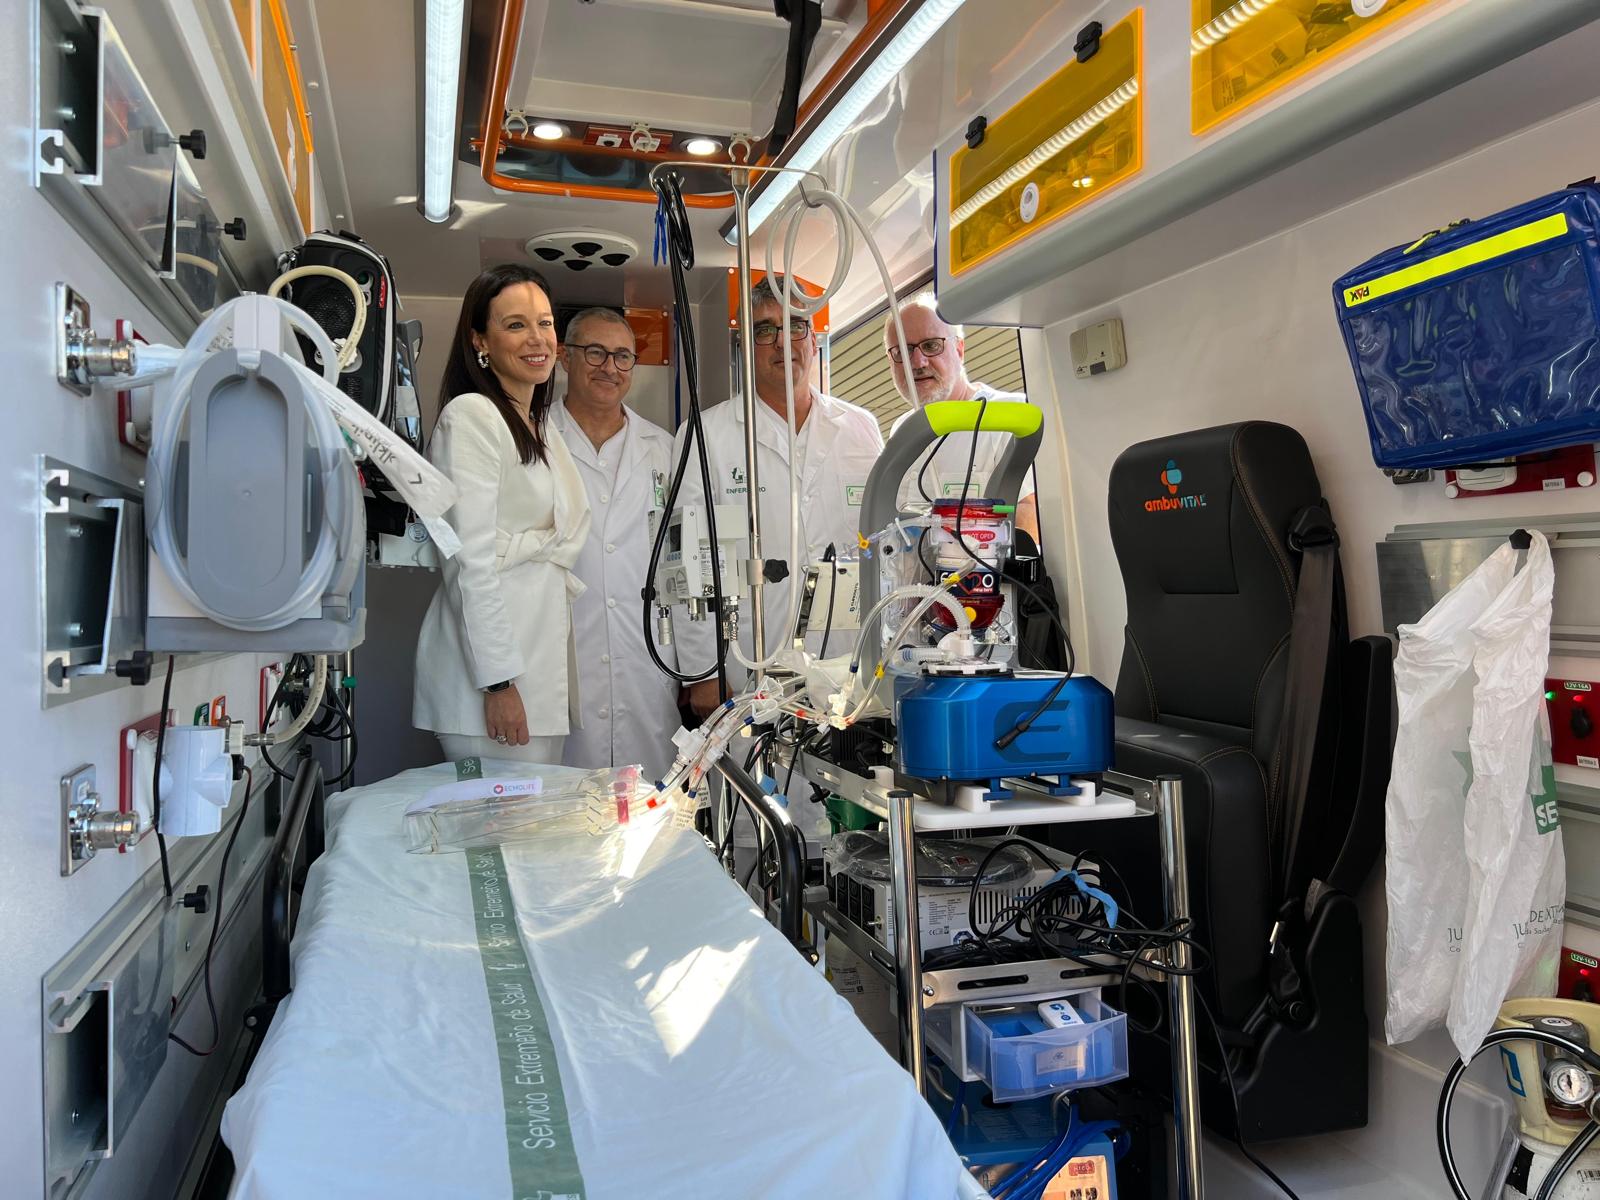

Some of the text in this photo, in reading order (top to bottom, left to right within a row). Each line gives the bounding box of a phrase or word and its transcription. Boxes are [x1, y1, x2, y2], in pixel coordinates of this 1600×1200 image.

[1349, 286, 1370, 302] PAX
[1144, 494, 1207, 512] ambuVITAL
[498, 982, 556, 1149] Servicio Extremeño de Salud
